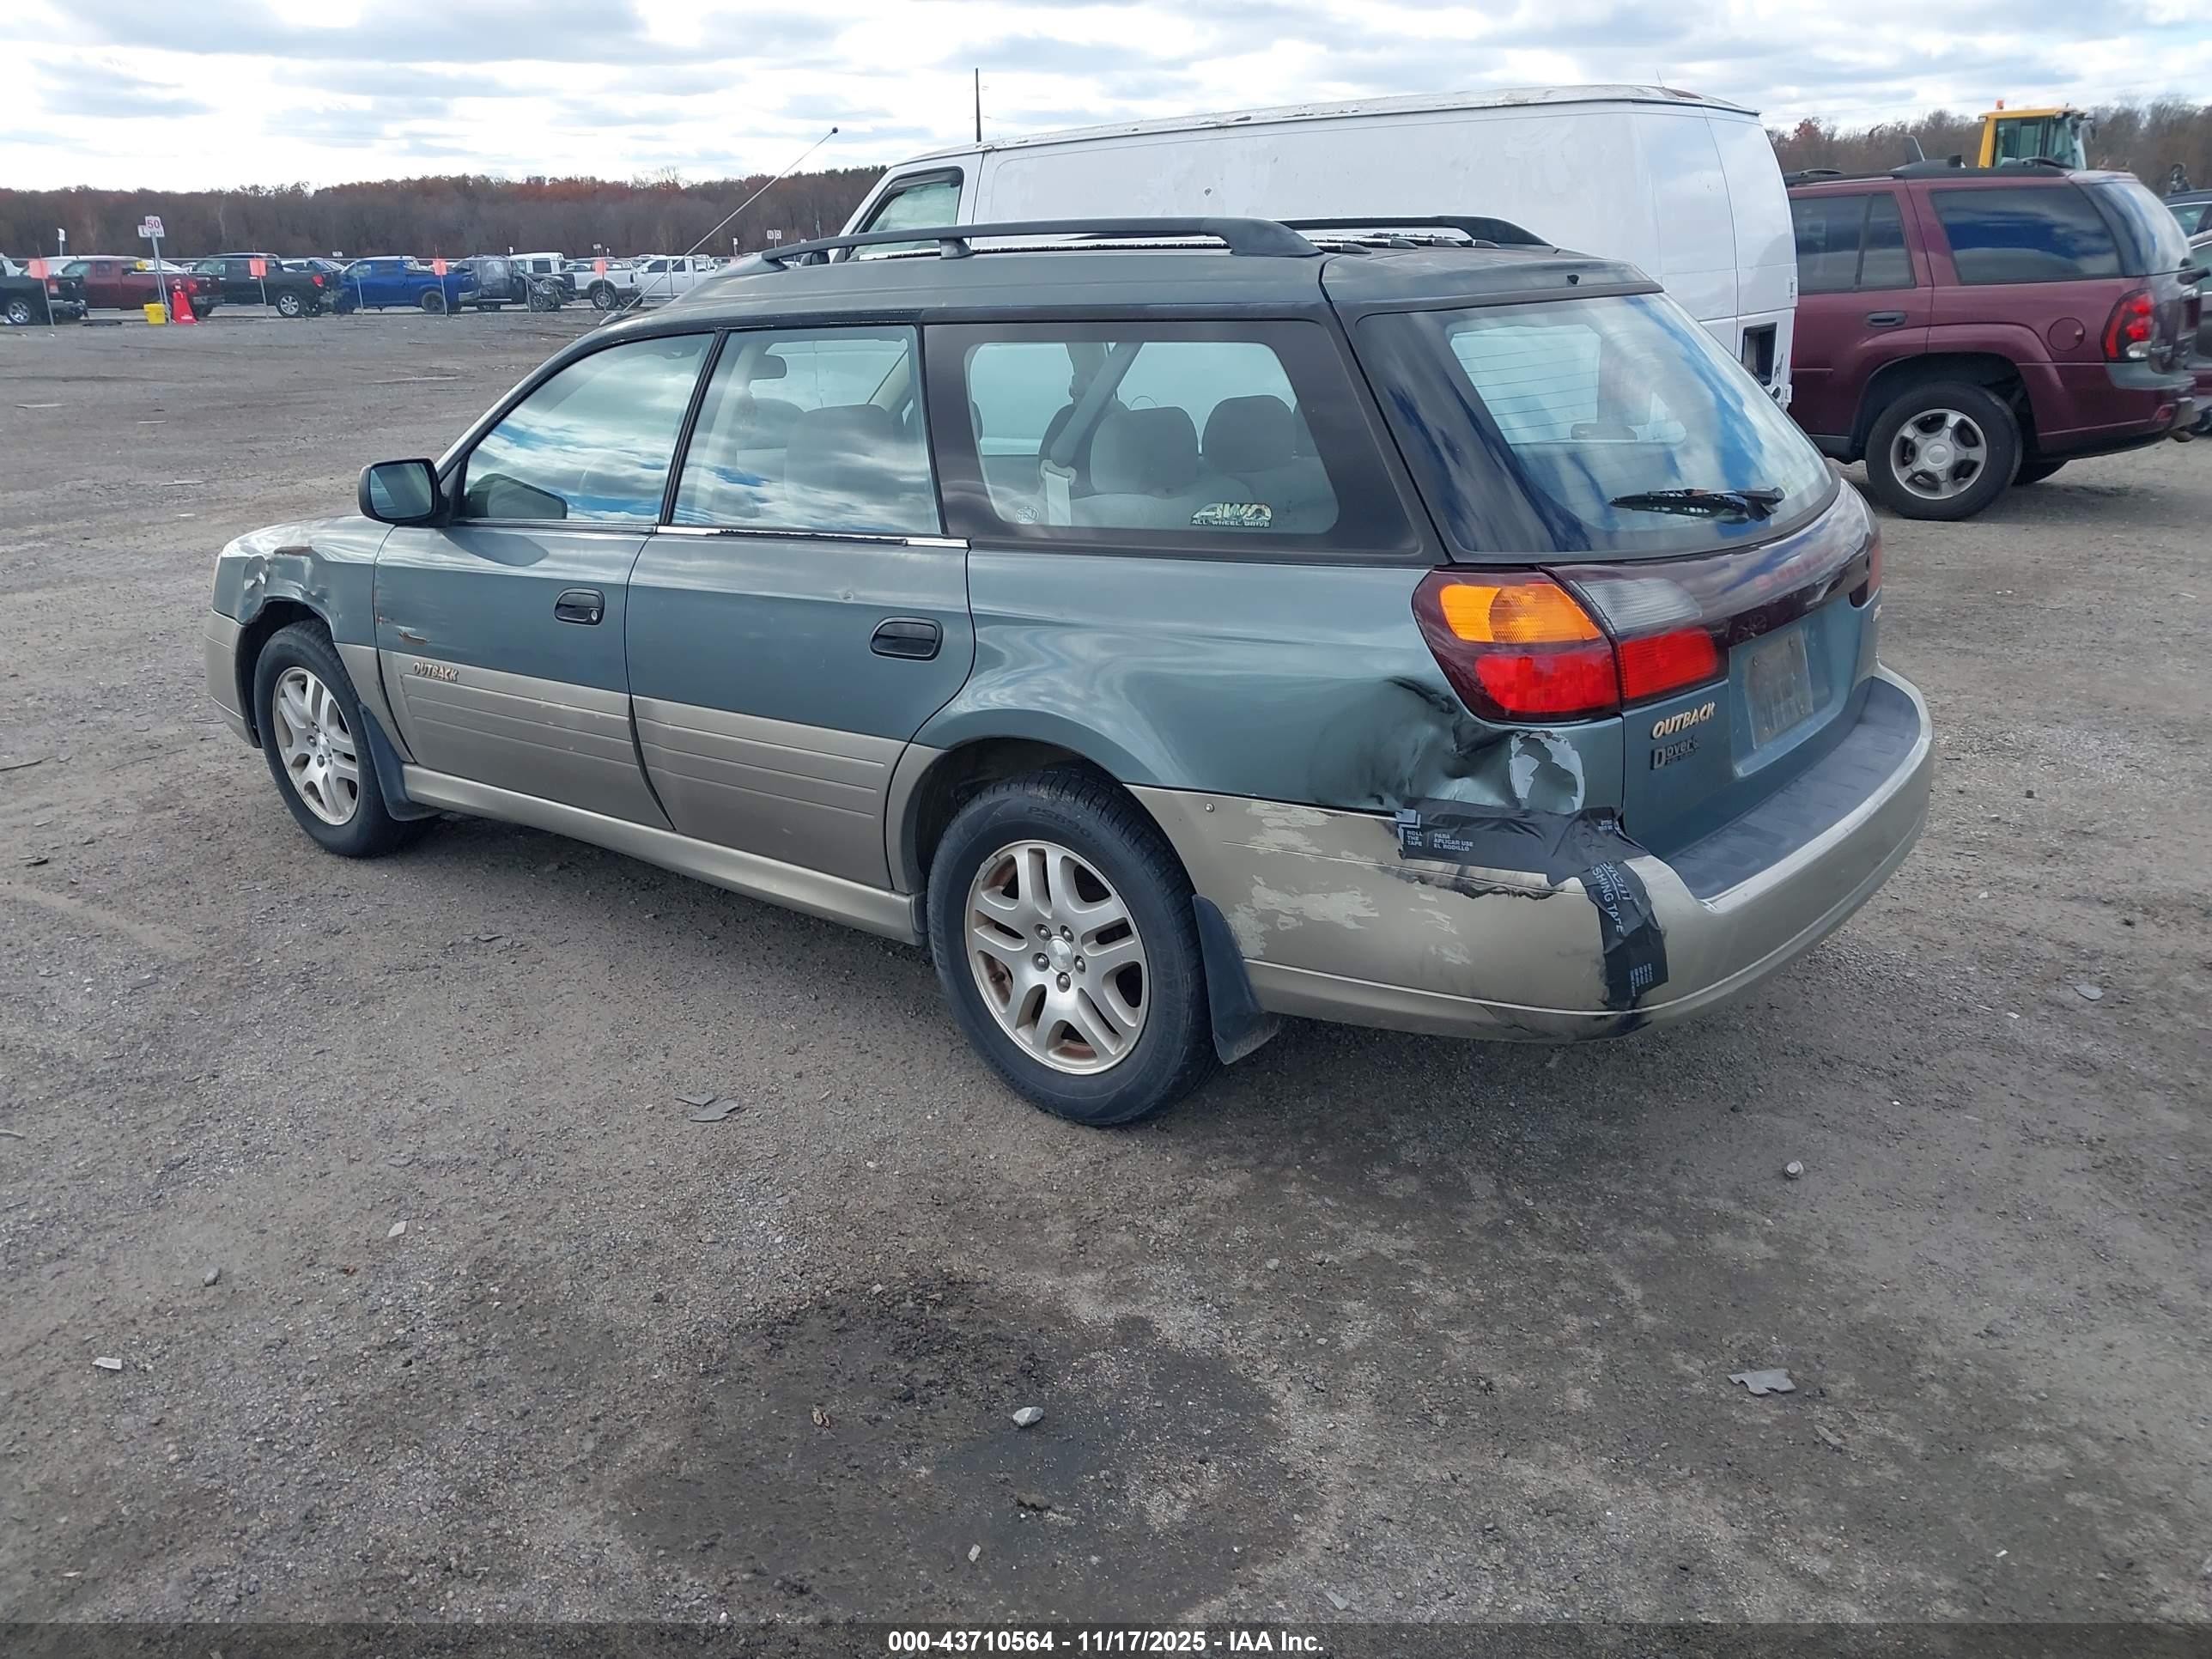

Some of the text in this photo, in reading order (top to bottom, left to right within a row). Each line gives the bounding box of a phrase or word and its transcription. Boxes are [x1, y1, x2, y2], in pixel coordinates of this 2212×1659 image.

[147, 219, 160, 228] 50
[413, 661, 459, 681] OUTBACK
[1650, 701, 1716, 739] OUTBACK
